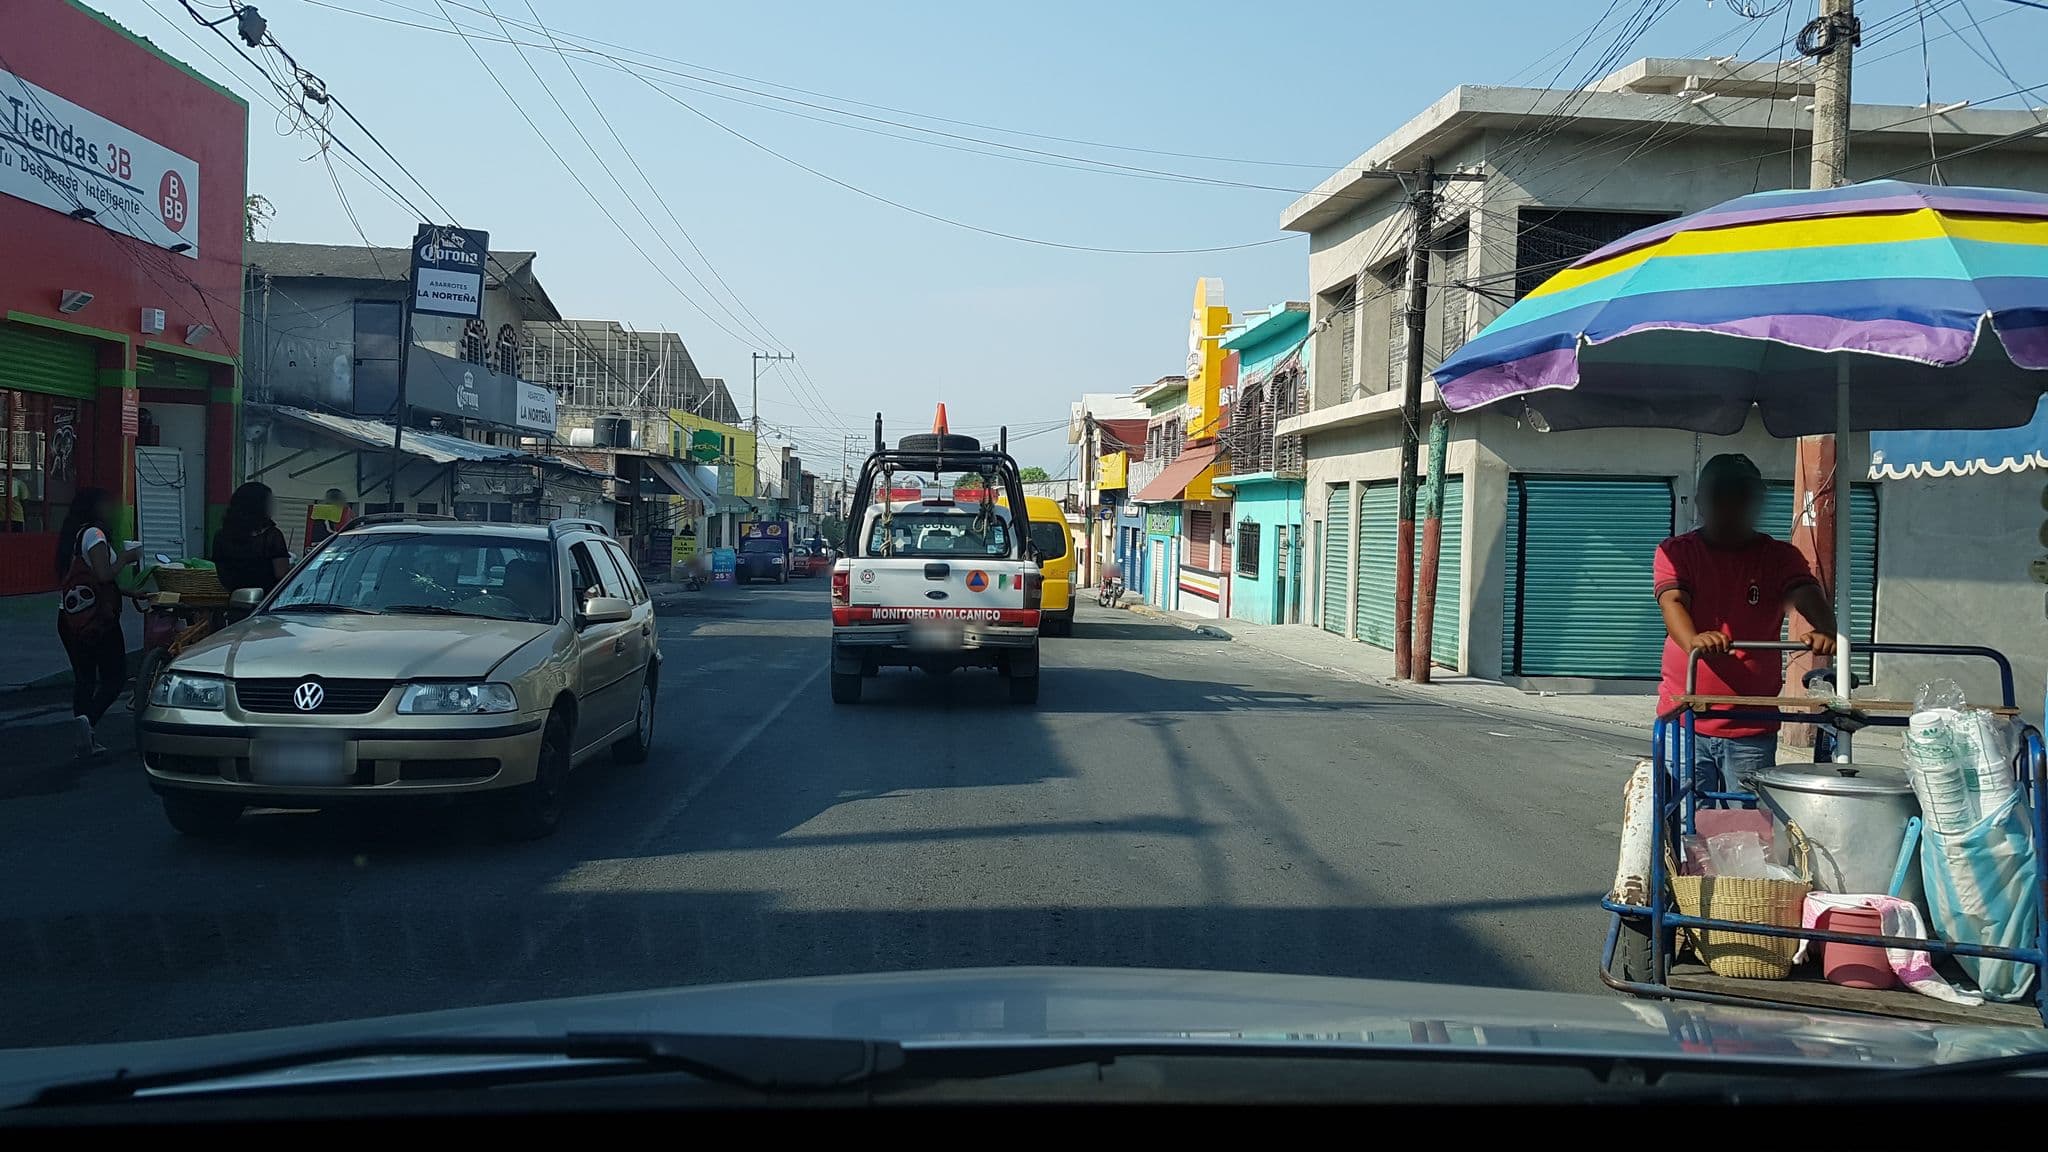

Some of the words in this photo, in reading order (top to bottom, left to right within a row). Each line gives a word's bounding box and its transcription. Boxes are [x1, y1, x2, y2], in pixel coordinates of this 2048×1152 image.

[9, 96, 98, 165] Tiendas
[106, 143, 132, 181] 3B
[21, 154, 79, 191] Despensa
[86, 180, 140, 215] Inteligente
[170, 175, 179, 198] B
[420, 244, 479, 266] Corona
[418, 290, 429, 298] LA
[432, 292, 476, 303] NORTEÑA
[521, 406, 528, 419] LA
[872, 608, 936, 620] MONITOREO
[938, 609, 1001, 621] VOLCANICO
